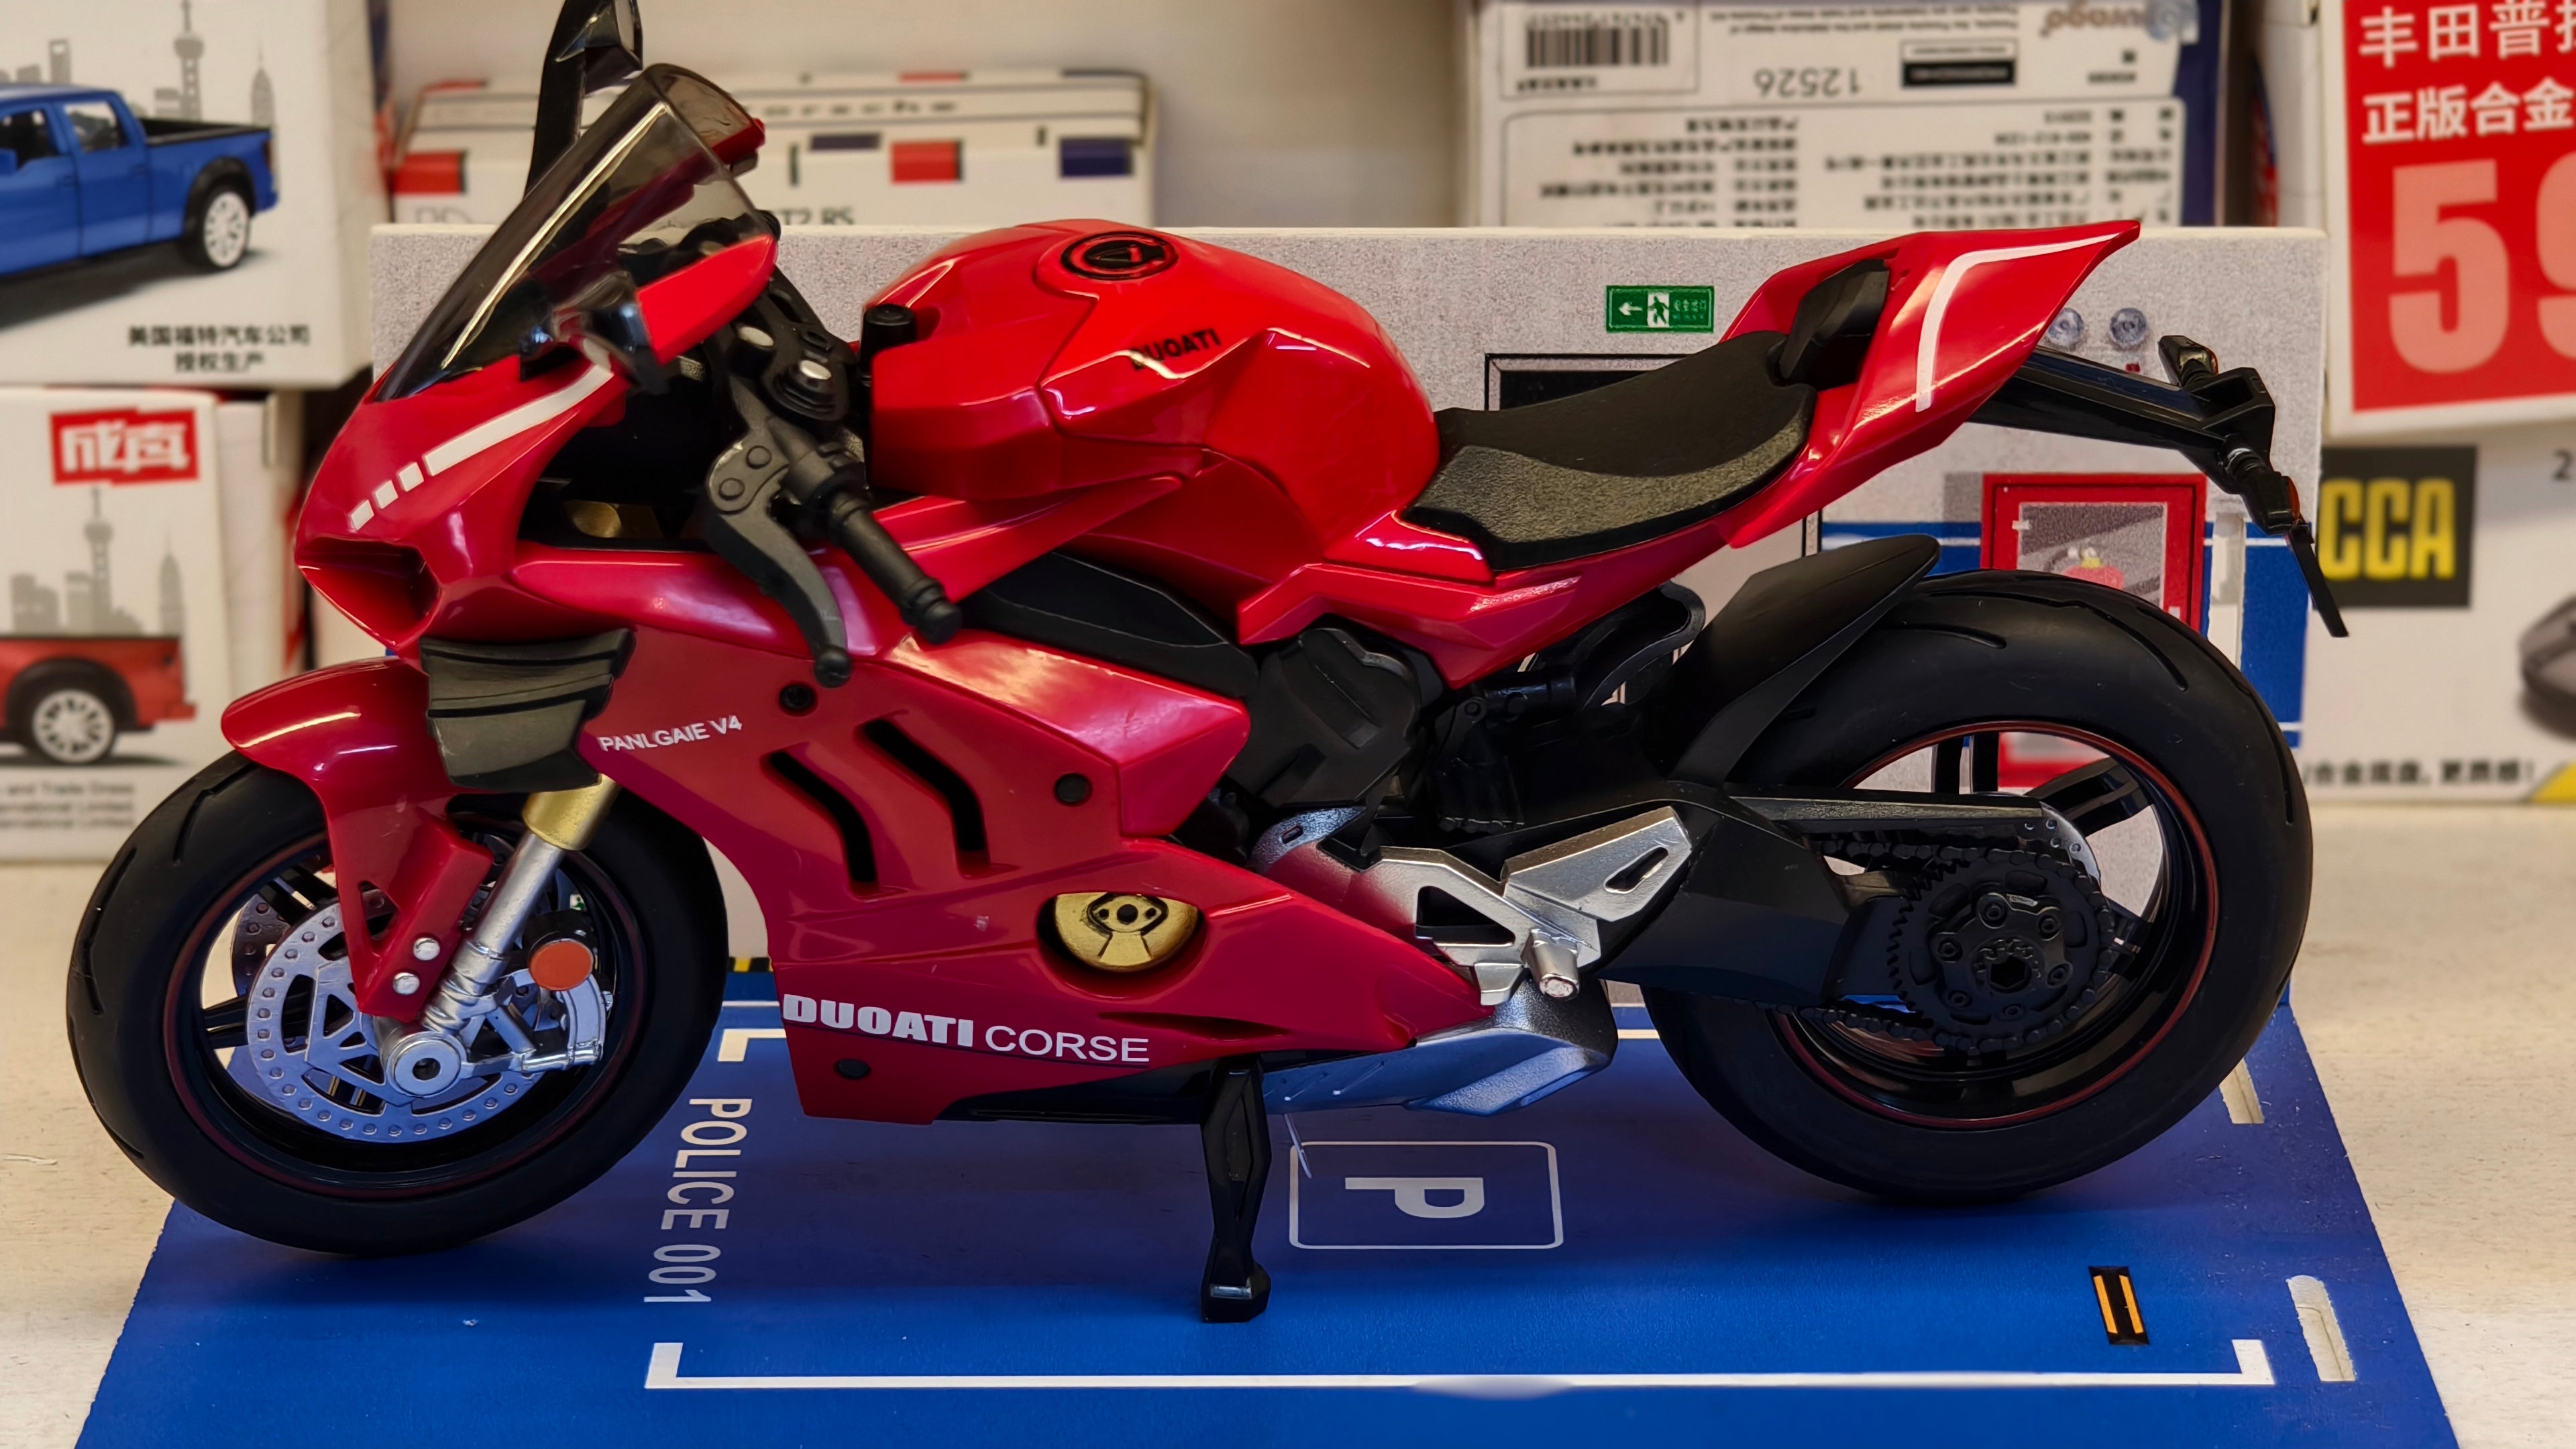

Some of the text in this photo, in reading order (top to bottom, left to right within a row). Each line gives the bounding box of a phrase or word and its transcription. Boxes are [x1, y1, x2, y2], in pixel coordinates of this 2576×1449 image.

[1754, 66, 1862, 98] 12526
[2363, 76, 2576, 144] 正版合金
[2318, 478, 2456, 581] CCA
[596, 714, 743, 752] PANLGAIE V4
[783, 994, 1150, 1063] DUOATI CORSE
[643, 1098, 753, 1303] POLICE 001
[1345, 1177, 1485, 1218] P
